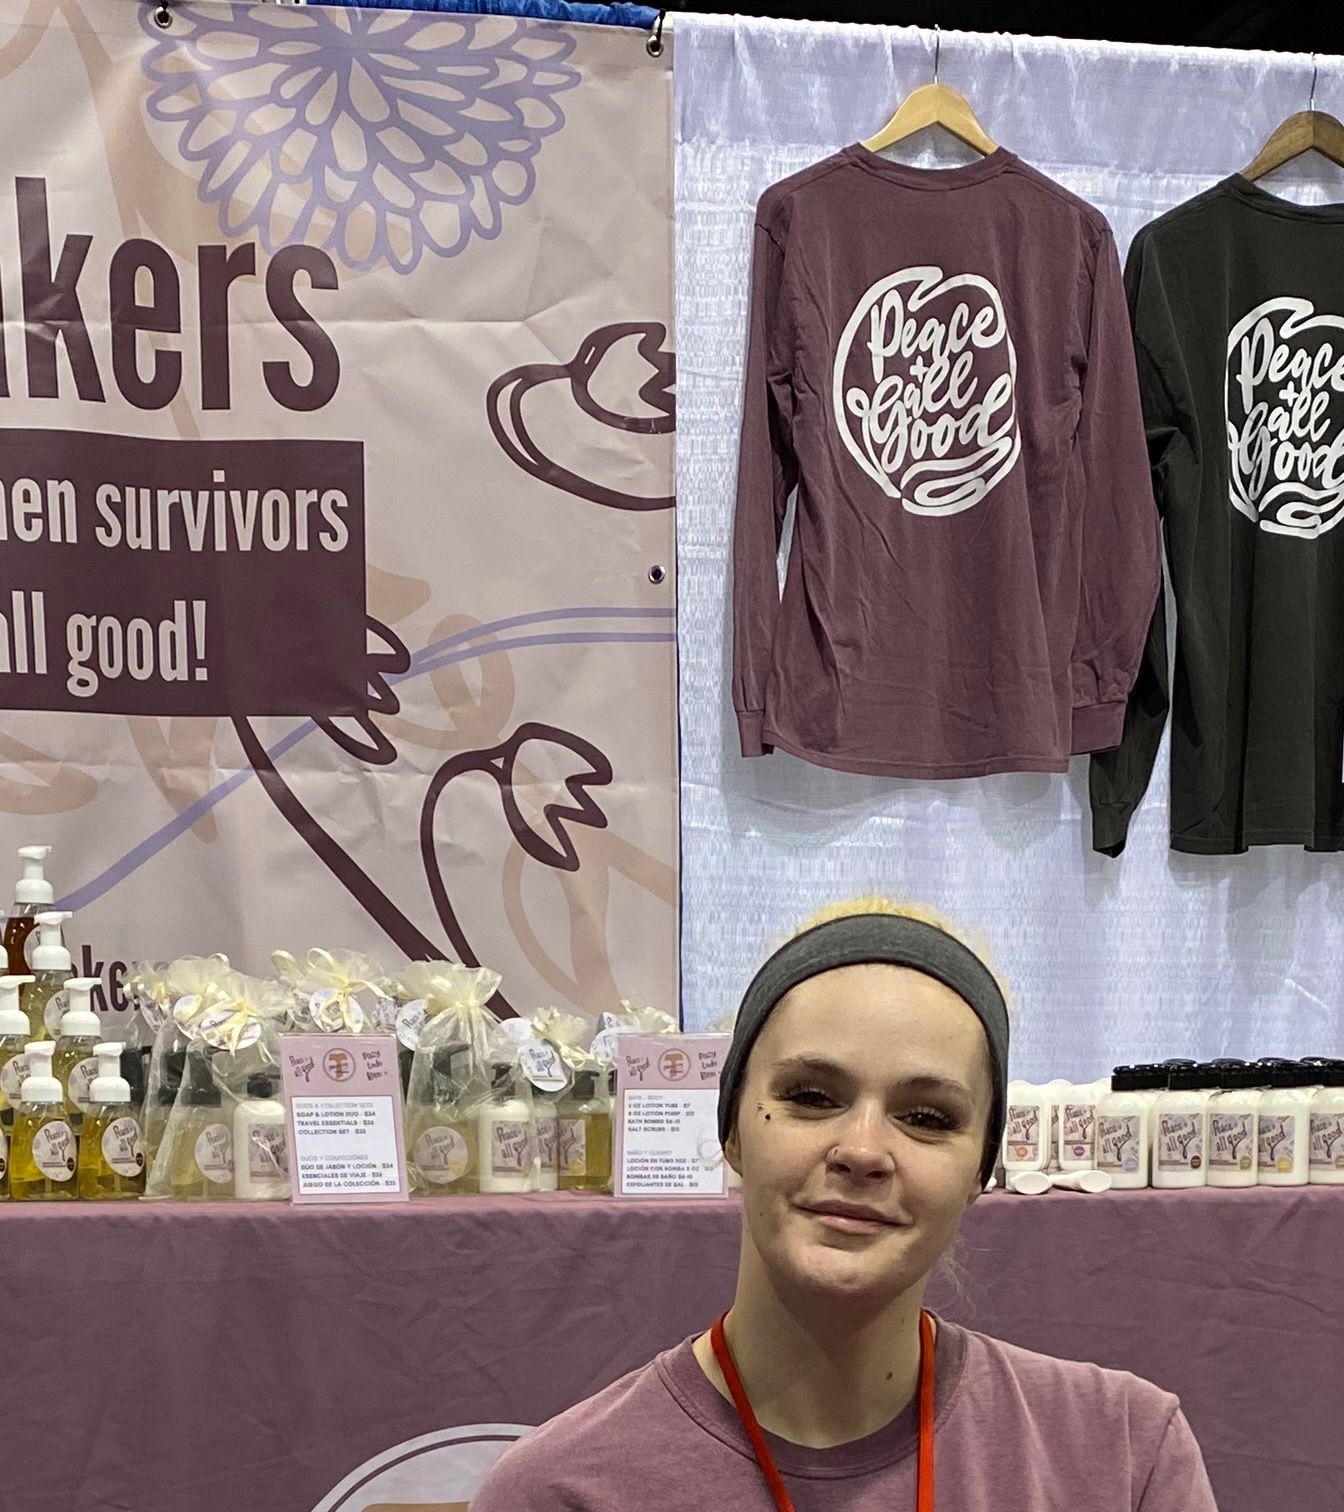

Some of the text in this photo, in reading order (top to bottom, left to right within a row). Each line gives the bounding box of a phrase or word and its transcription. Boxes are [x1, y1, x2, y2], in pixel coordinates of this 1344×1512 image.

[867, 290, 1006, 383] Peace
[94, 470, 349, 553] survivors
[66, 599, 209, 695] good!
